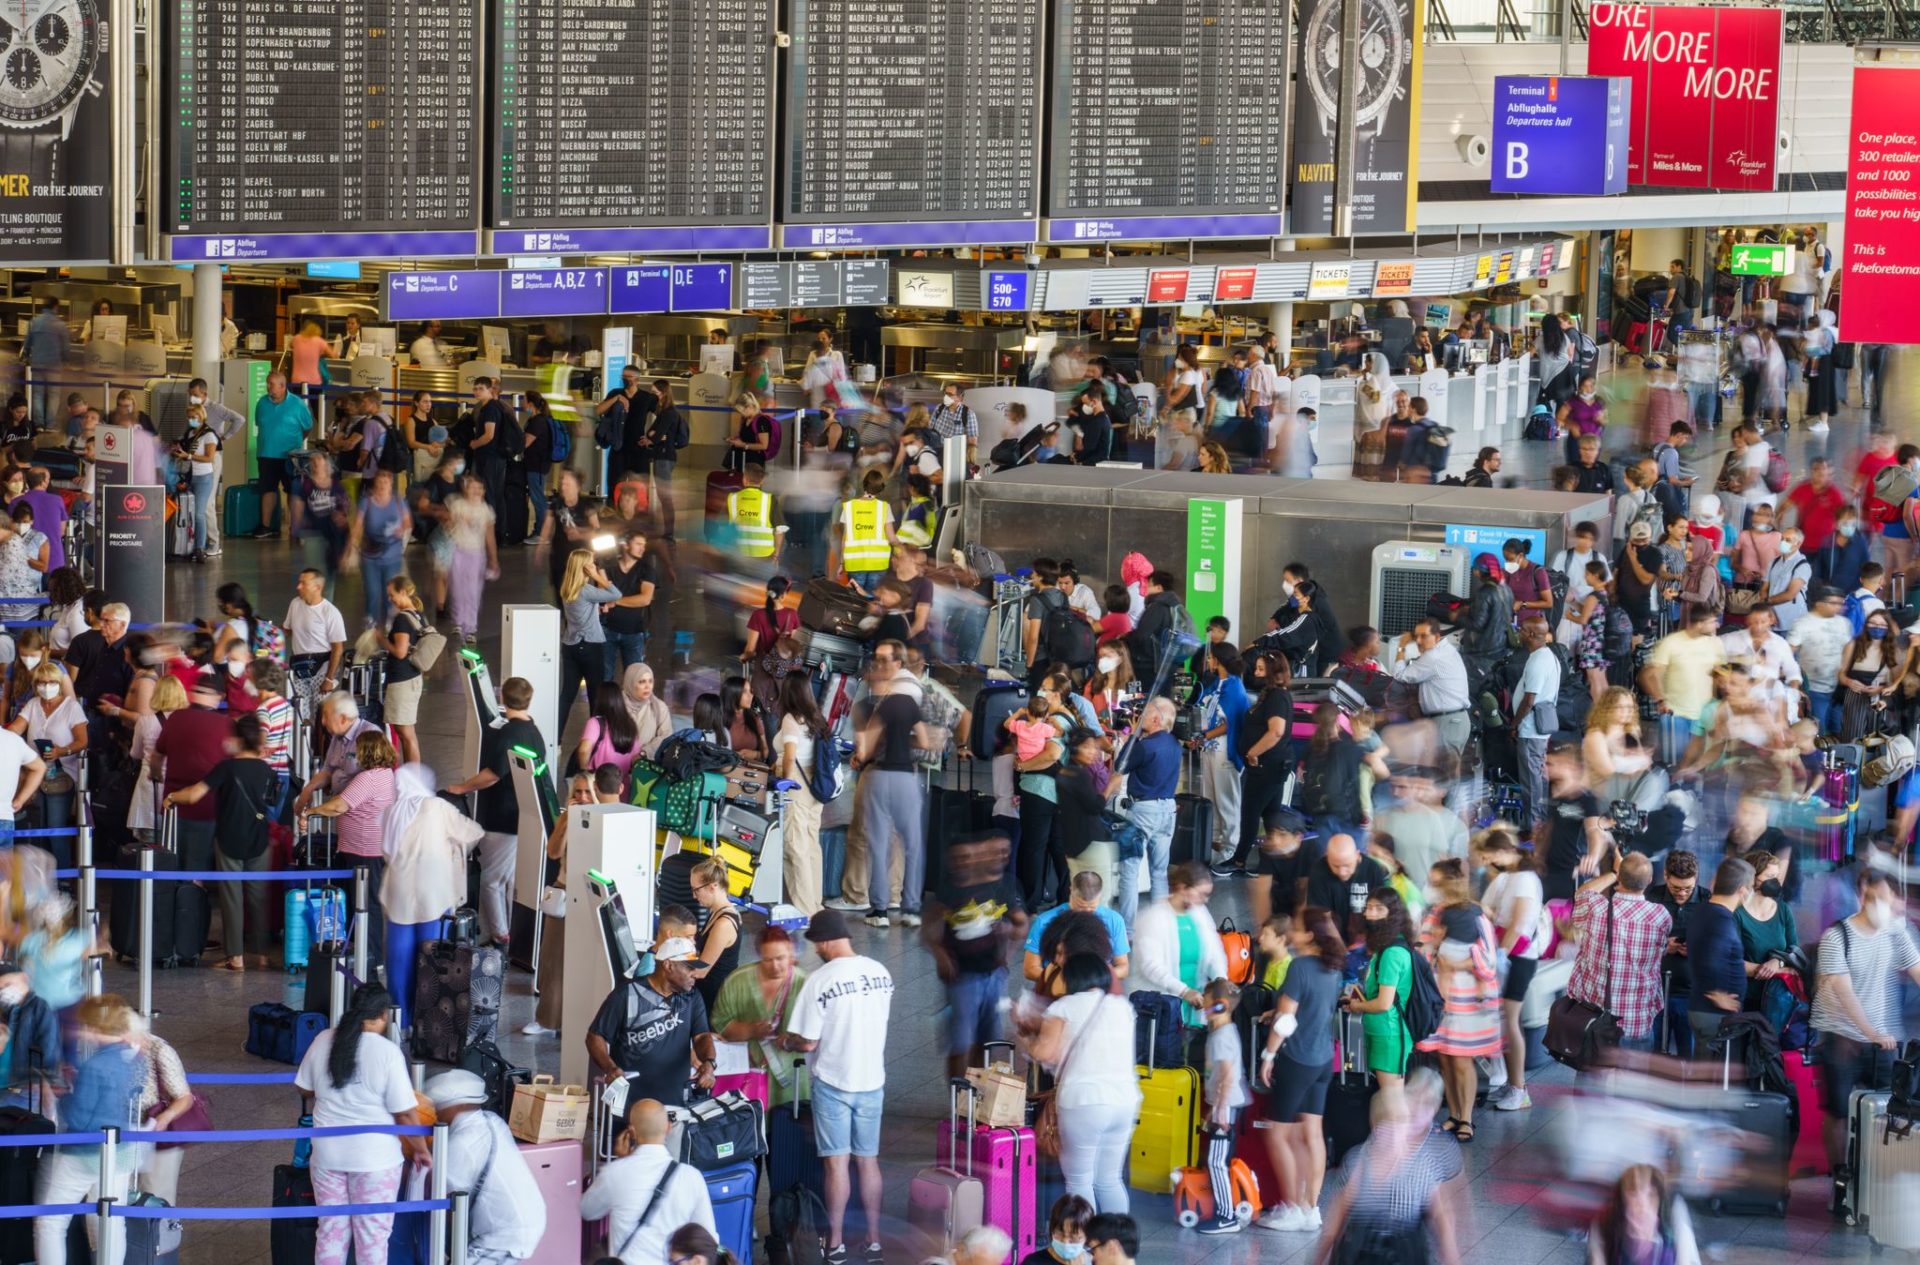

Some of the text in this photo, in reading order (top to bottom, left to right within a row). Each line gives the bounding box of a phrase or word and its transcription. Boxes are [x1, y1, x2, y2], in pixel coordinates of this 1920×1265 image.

[218, 3, 236, 12] 1519
[246, 4, 270, 12] PARIS
[293, 4, 302, 13] DE
[307, 4, 336, 14] GAULLE
[562, 10, 584, 18] SOFIA
[222, 15, 236, 23] 244
[246, 27, 331, 36] BERLIN-BRANDENBURG
[246, 39, 331, 48] KOPENHAGEN-KASTRUP
[579, 43, 618, 51] FRANCISCO
[1622, 30, 1711, 63] MORE
[217, 62, 269, 70] 3432 BASEL
[246, 74, 275, 82] DUBLIN
[1684, 66, 1772, 100] MORE
[246, 85, 279, 94] HOUSTON
[562, 87, 609, 95] LOS ANGELES
[1508, 86, 1555, 96] Terminal 1
[246, 97, 274, 105] TROMSO
[1507, 104, 1557, 115] Abflughalle
[221, 120, 274, 128] 417 ZAGREB
[1506, 116, 1572, 126] Departures hall
[245, 132, 288, 140] STUTTGART
[292, 132, 306, 140] HBF
[1859, 132, 1917, 146] One place,
[245, 155, 325, 163] GOETTINGEN-KASSEL
[1506, 142, 1528, 178] B
[1858, 151, 1920, 162] 300 retailer
[1607, 144, 1614, 180] B
[1653, 161, 1702, 172] Miles & More
[560, 164, 590, 172] DETROIT
[560, 175, 590, 183] DETROIT
[1379, 172, 1403, 181] JOURNEY
[1856, 170, 1910, 181] and 1000
[244, 178, 273, 186] NEAPEL
[32, 186, 104, 196] FOR THE JOURNEY
[244, 189, 296, 198] DALLAS-FORT
[586, 186, 594, 194] DE
[1855, 189, 1916, 201] possibilities
[244, 200, 268, 209] KAIRO
[244, 212, 283, 220] BORDEAUX
[1854, 207, 1878, 218] take
[1879, 210, 1900, 221] you
[24, 214, 62, 224] BOUTIQUE
[836, 228, 853, 236] Abflug
[552, 234, 569, 242] Abflug
[836, 237, 863, 245] Departures
[237, 240, 256, 248] Abflug
[237, 249, 267, 257] Departures
[1853, 244, 1886, 255] This is
[525, 273, 542, 281] Abflug
[675, 269, 693, 286] D,E
[1316, 269, 1348, 278] TICKETS
[1381, 271, 1409, 279] TICKETS
[421, 276, 437, 284] Abflug
[421, 275, 458, 292] Departures C
[525, 272, 585, 290] Departures A,B,Z
[993, 297, 1011, 306] 570
[627, 1012, 684, 1045] Reebok
